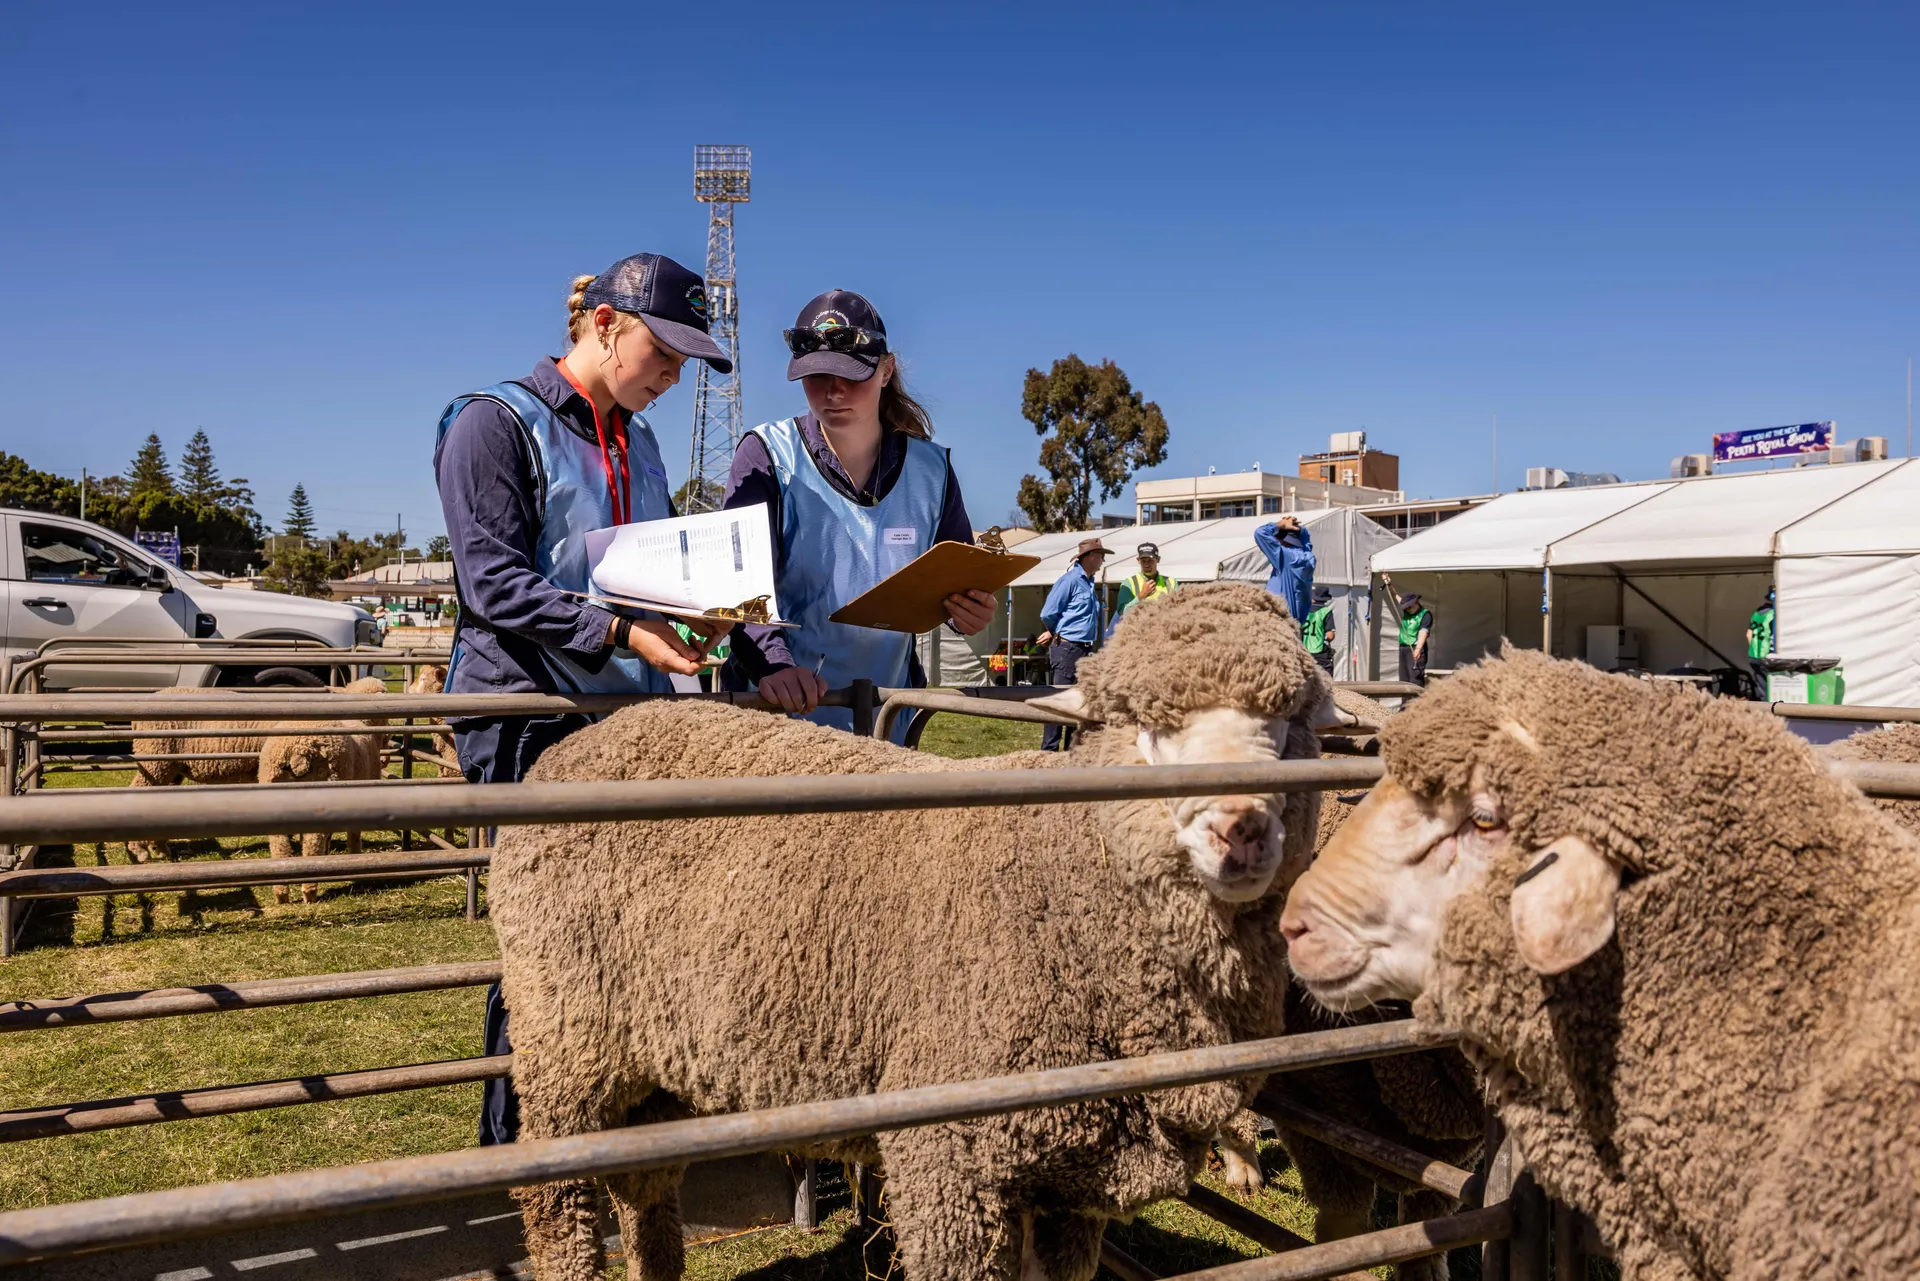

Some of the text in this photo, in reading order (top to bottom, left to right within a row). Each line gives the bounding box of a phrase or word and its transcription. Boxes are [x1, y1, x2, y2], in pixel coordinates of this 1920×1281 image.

[1784, 425, 1800, 435] NEXT
[1727, 431, 1817, 459] PERTH ROYAL SHOW
[1302, 620, 1317, 637] 21
